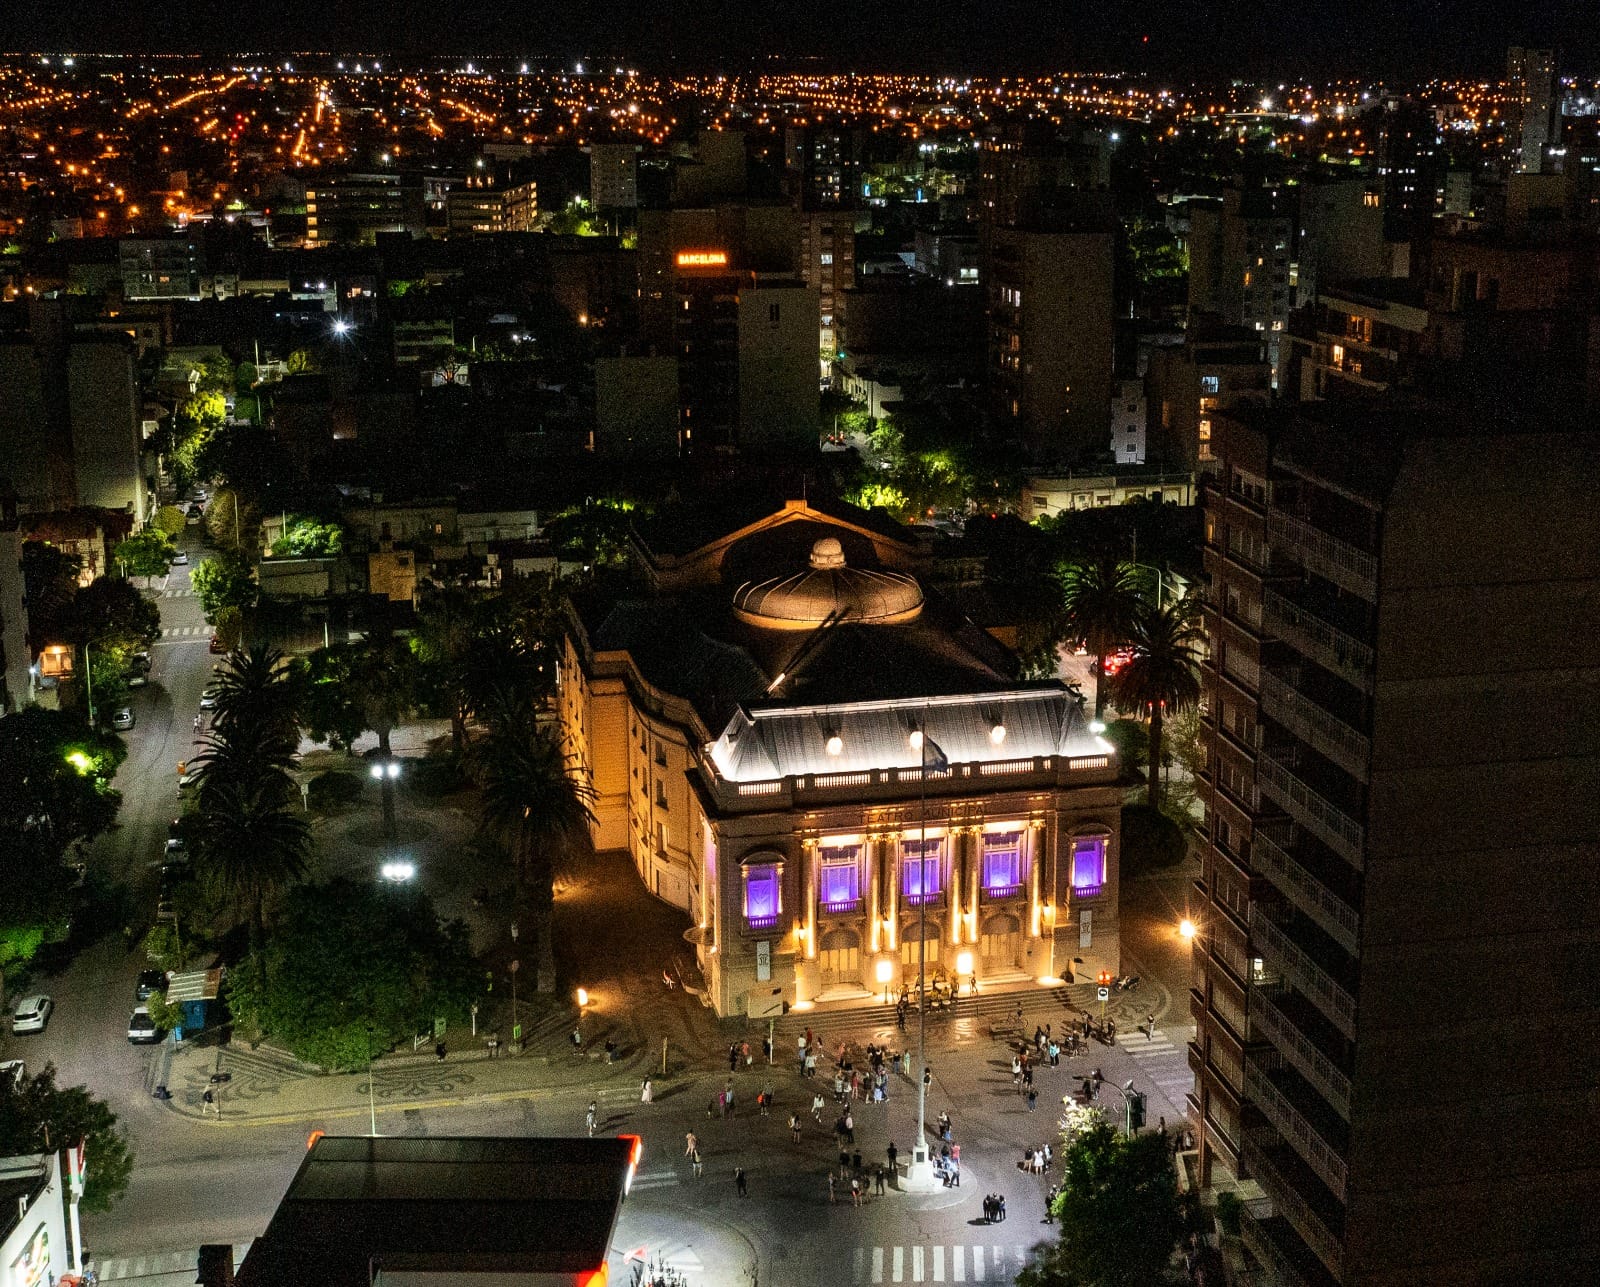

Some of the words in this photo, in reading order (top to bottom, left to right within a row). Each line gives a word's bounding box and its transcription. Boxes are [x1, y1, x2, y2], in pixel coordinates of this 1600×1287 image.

[678, 253, 727, 265] BARCELONA
[859, 811, 913, 824] TEATRO
[924, 804, 990, 820] MUNICIPAL
